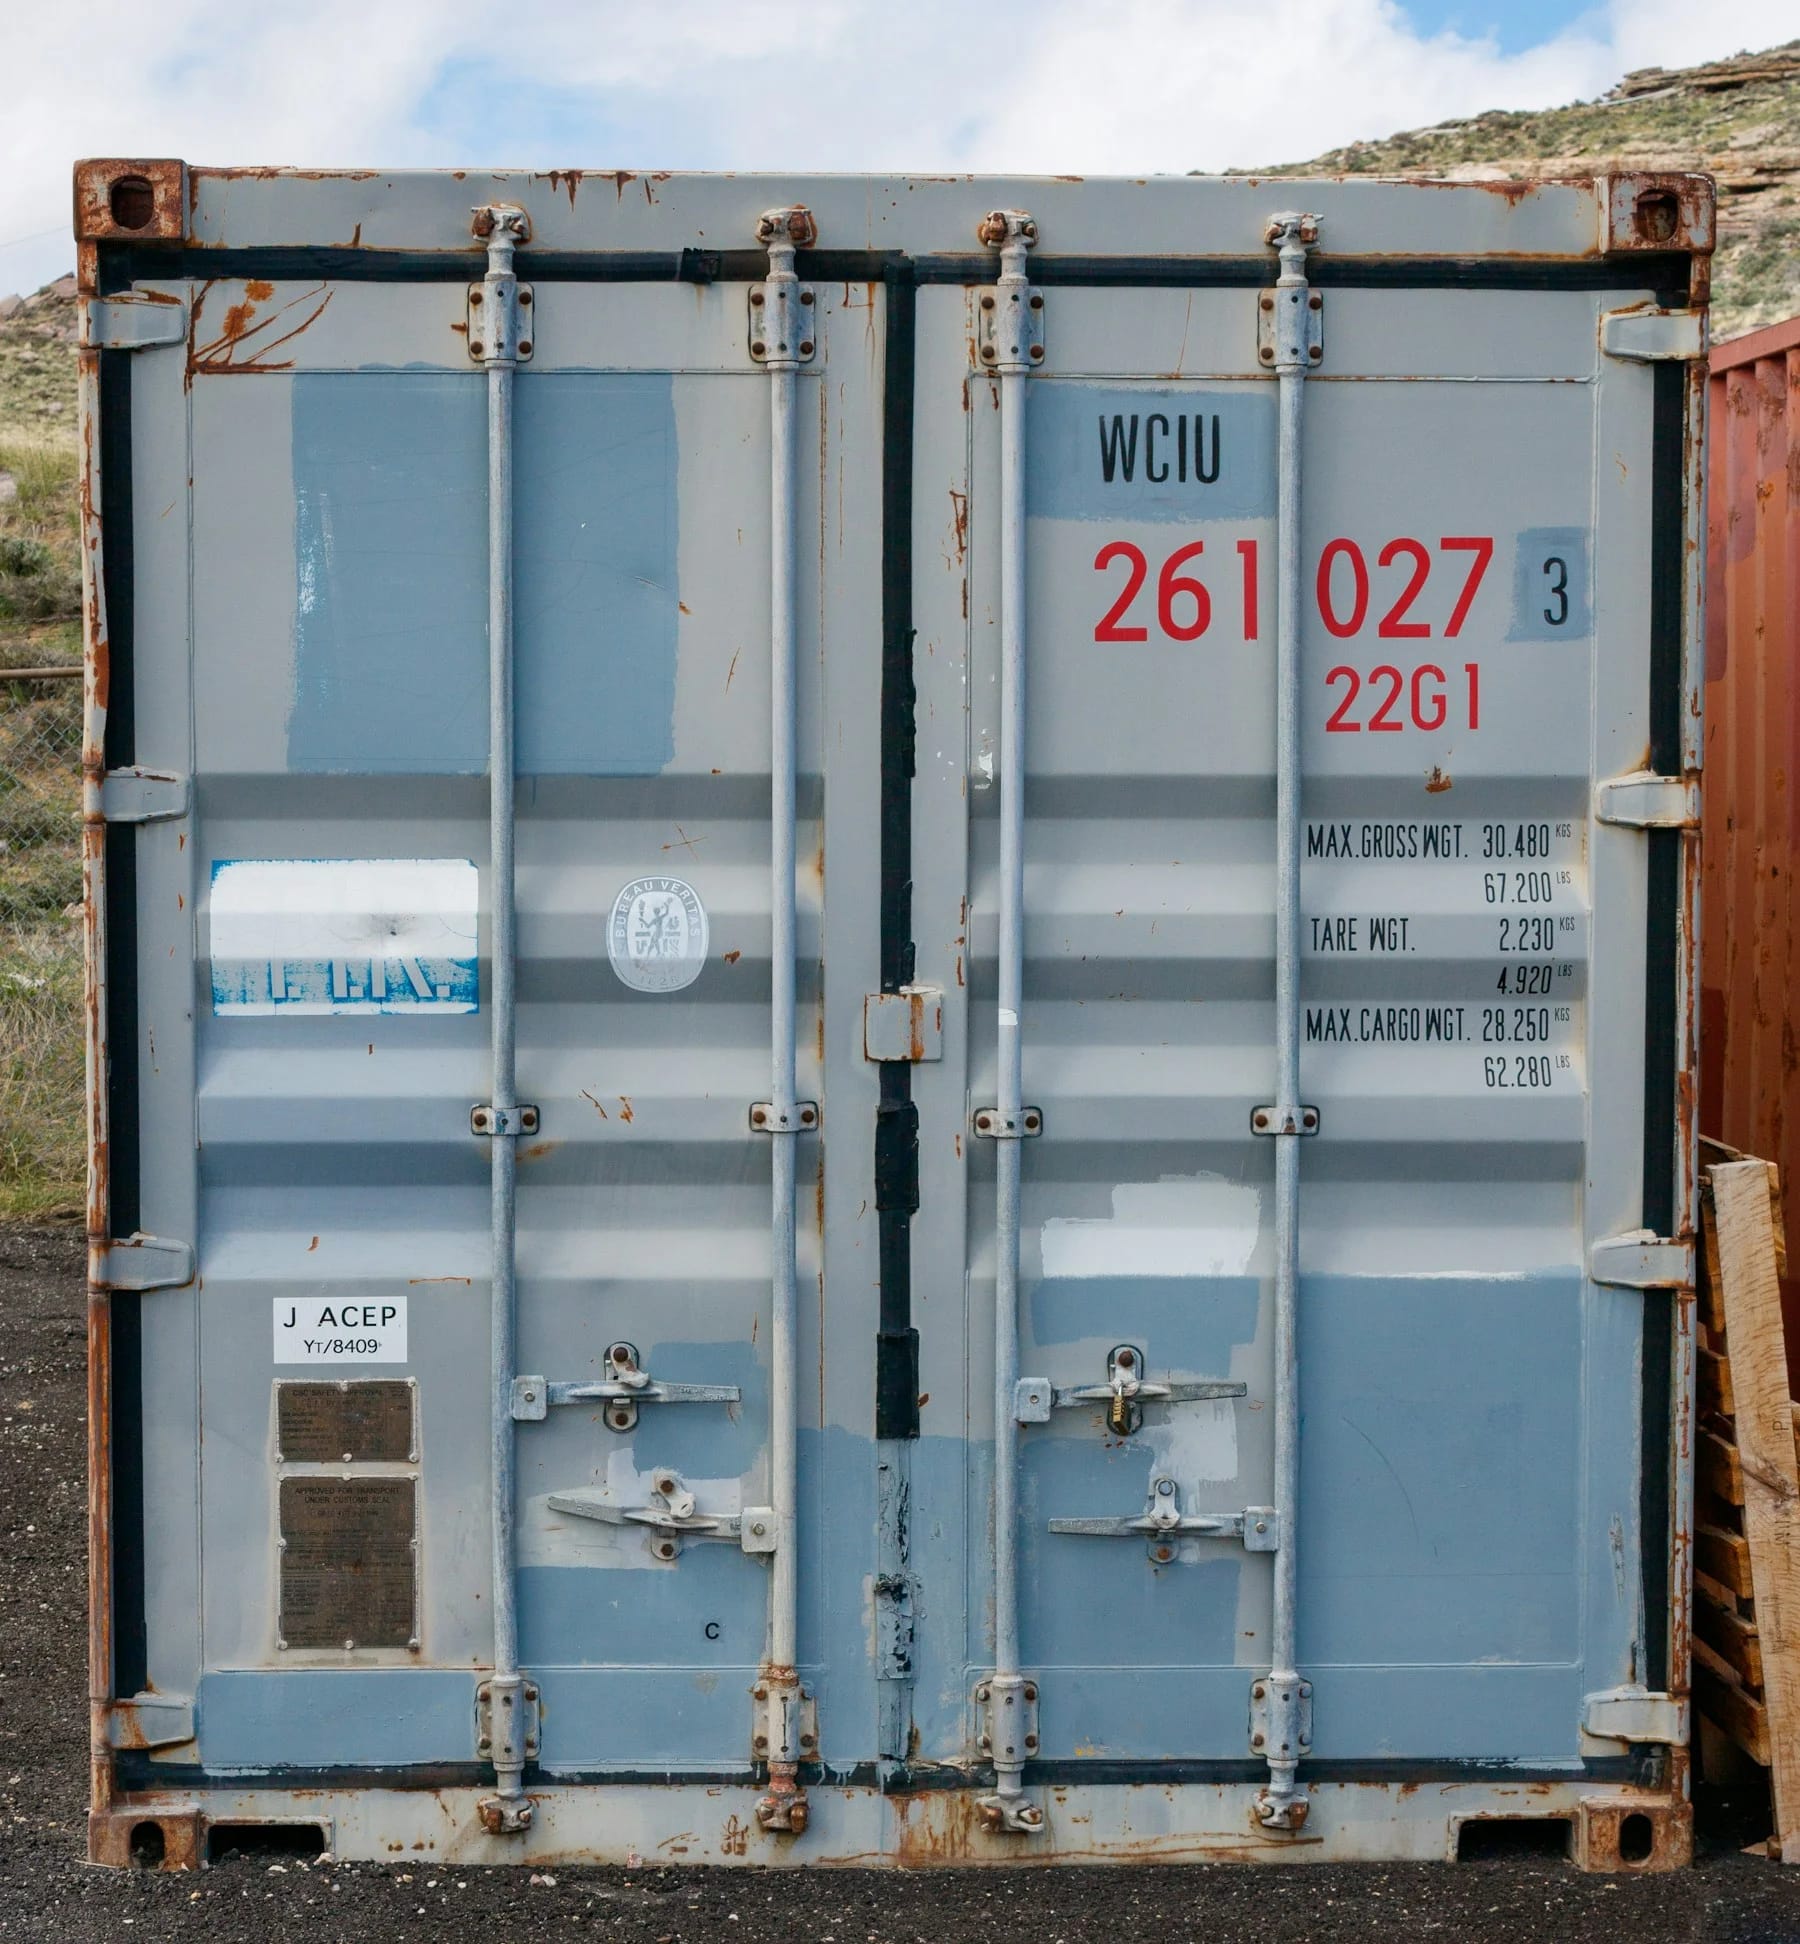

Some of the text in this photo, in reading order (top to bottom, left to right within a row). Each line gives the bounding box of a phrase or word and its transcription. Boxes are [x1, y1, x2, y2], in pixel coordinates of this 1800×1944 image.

[1099, 413, 1221, 484] WCIU
[1094, 536, 1568, 642] 261 027 3
[1325, 663, 1479, 732] 22G1
[1483, 824, 1550, 858] 30.480
[1555, 823, 1572, 838] KGS
[1484, 871, 1572, 903] 67.200 LBS
[615, 880, 701, 938] BUREAU VERITAS
[1311, 917, 1576, 952] TARE WGT. 2.230 KGS
[1497, 964, 1573, 995] 4.920 LBS
[1482, 1008, 1549, 1042] 28.250
[1554, 1007, 1571, 1022] KGS
[1484, 1056, 1571, 1088] 62.280 LBS
[283, 1307, 396, 1327] J ACEP
[705, 1622, 720, 1639] C
